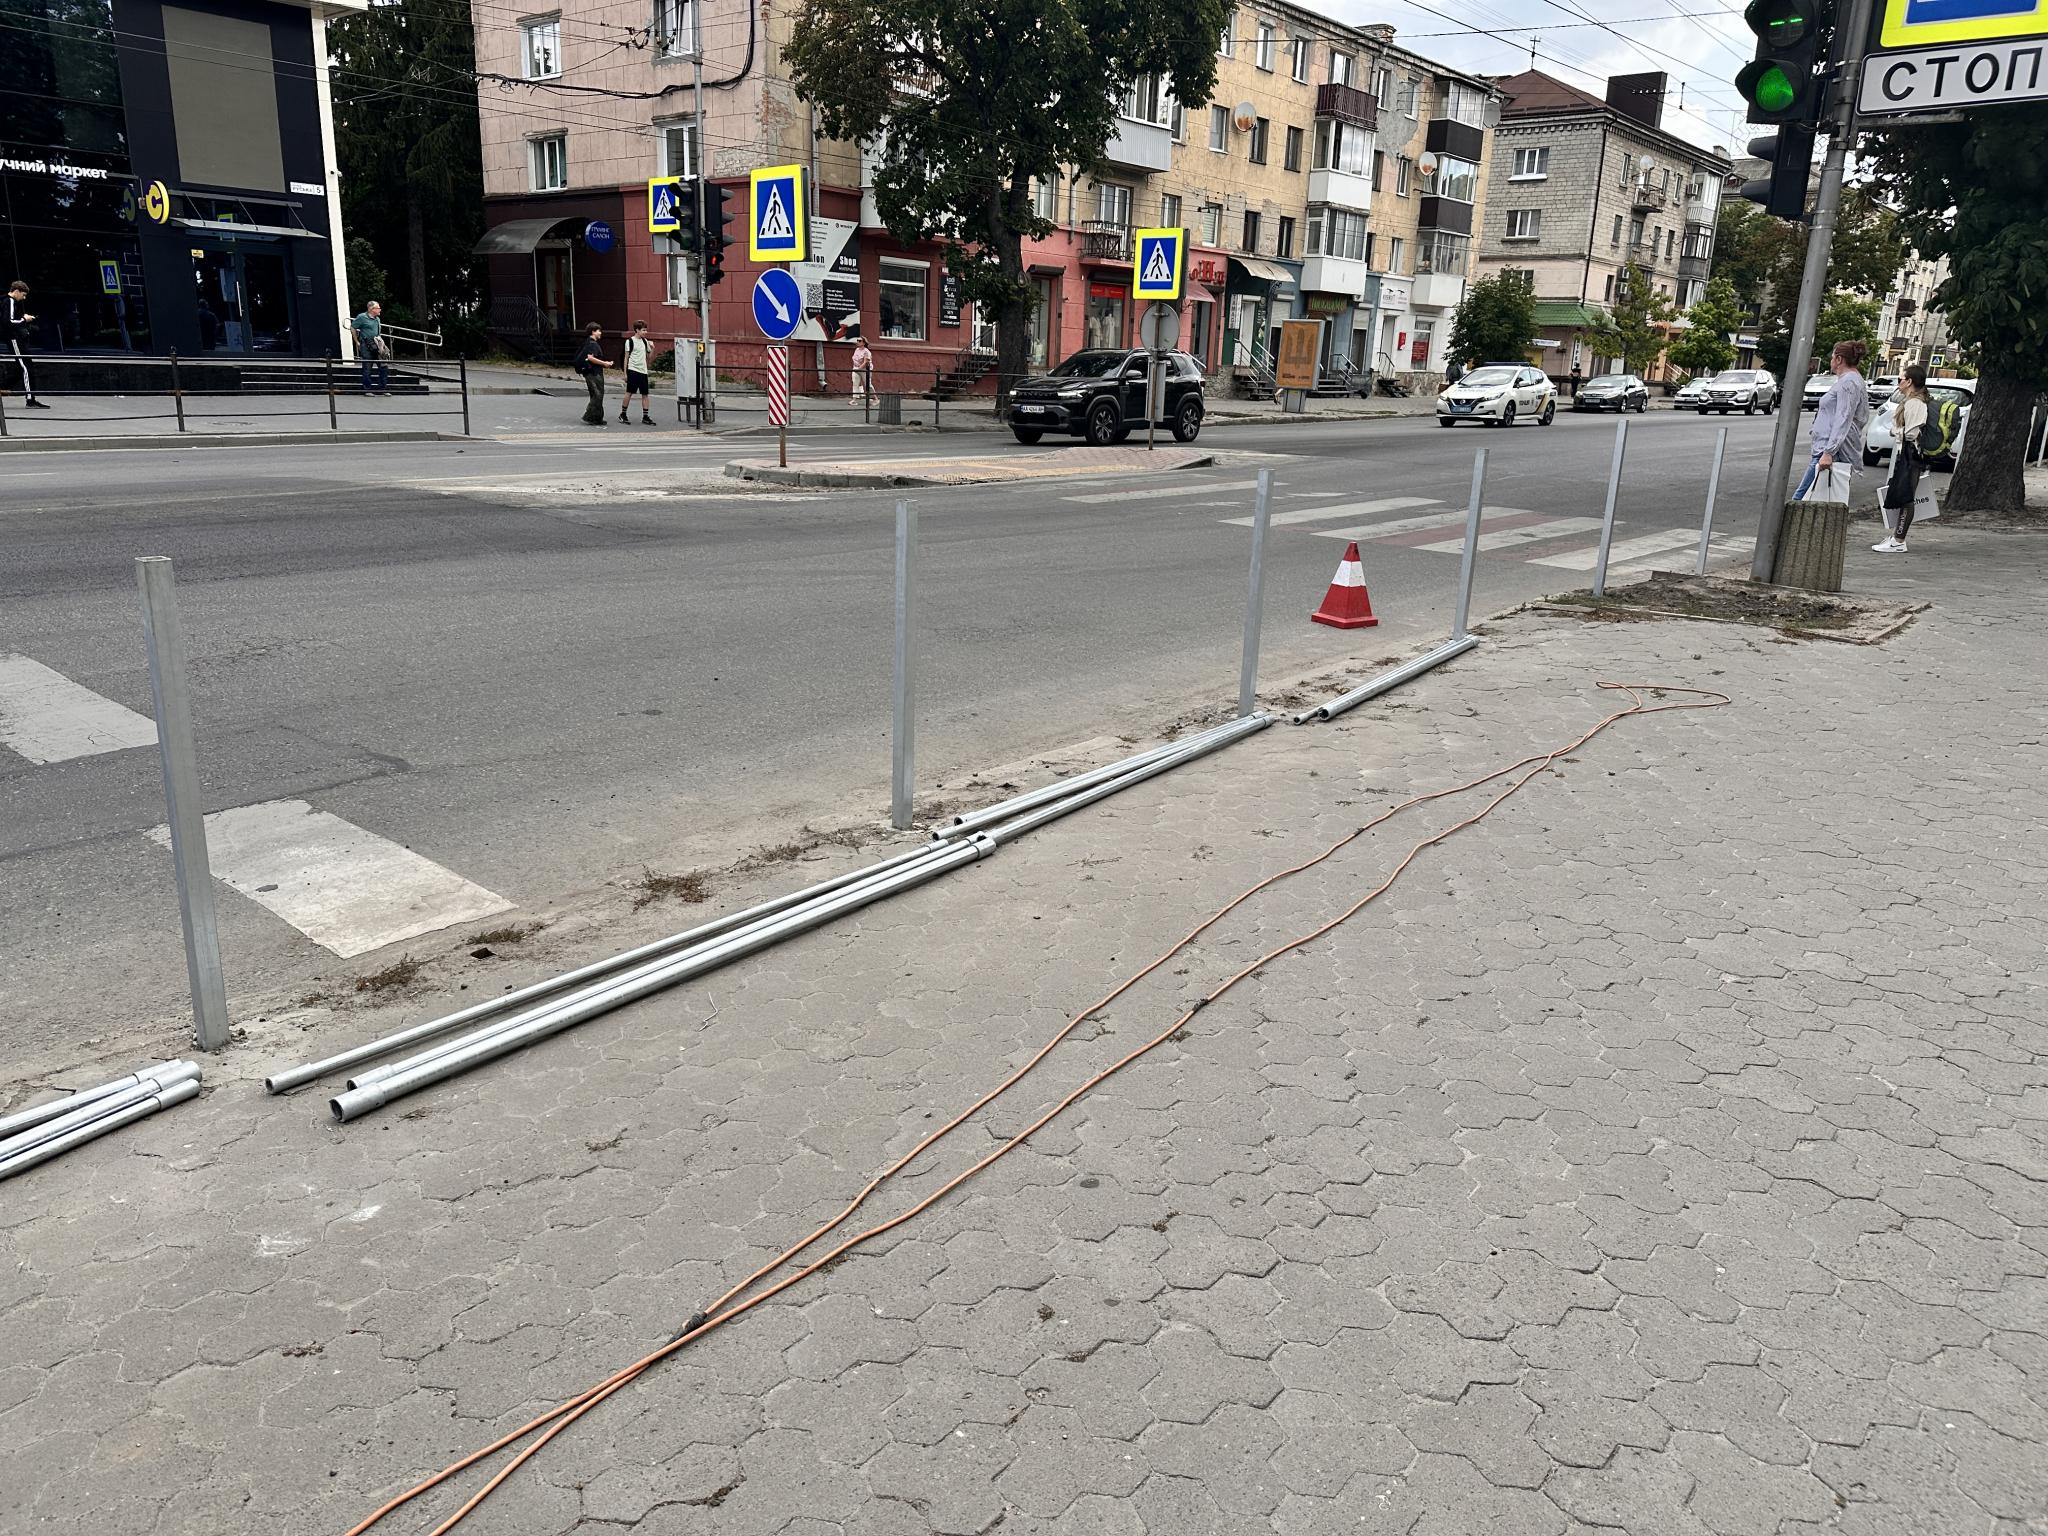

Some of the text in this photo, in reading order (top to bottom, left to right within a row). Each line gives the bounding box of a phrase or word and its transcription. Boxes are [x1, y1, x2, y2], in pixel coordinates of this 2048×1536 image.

[1881, 46, 2044, 101] СТОП
[49, 163, 108, 180] маркет
[839, 255, 857, 267] Shop
